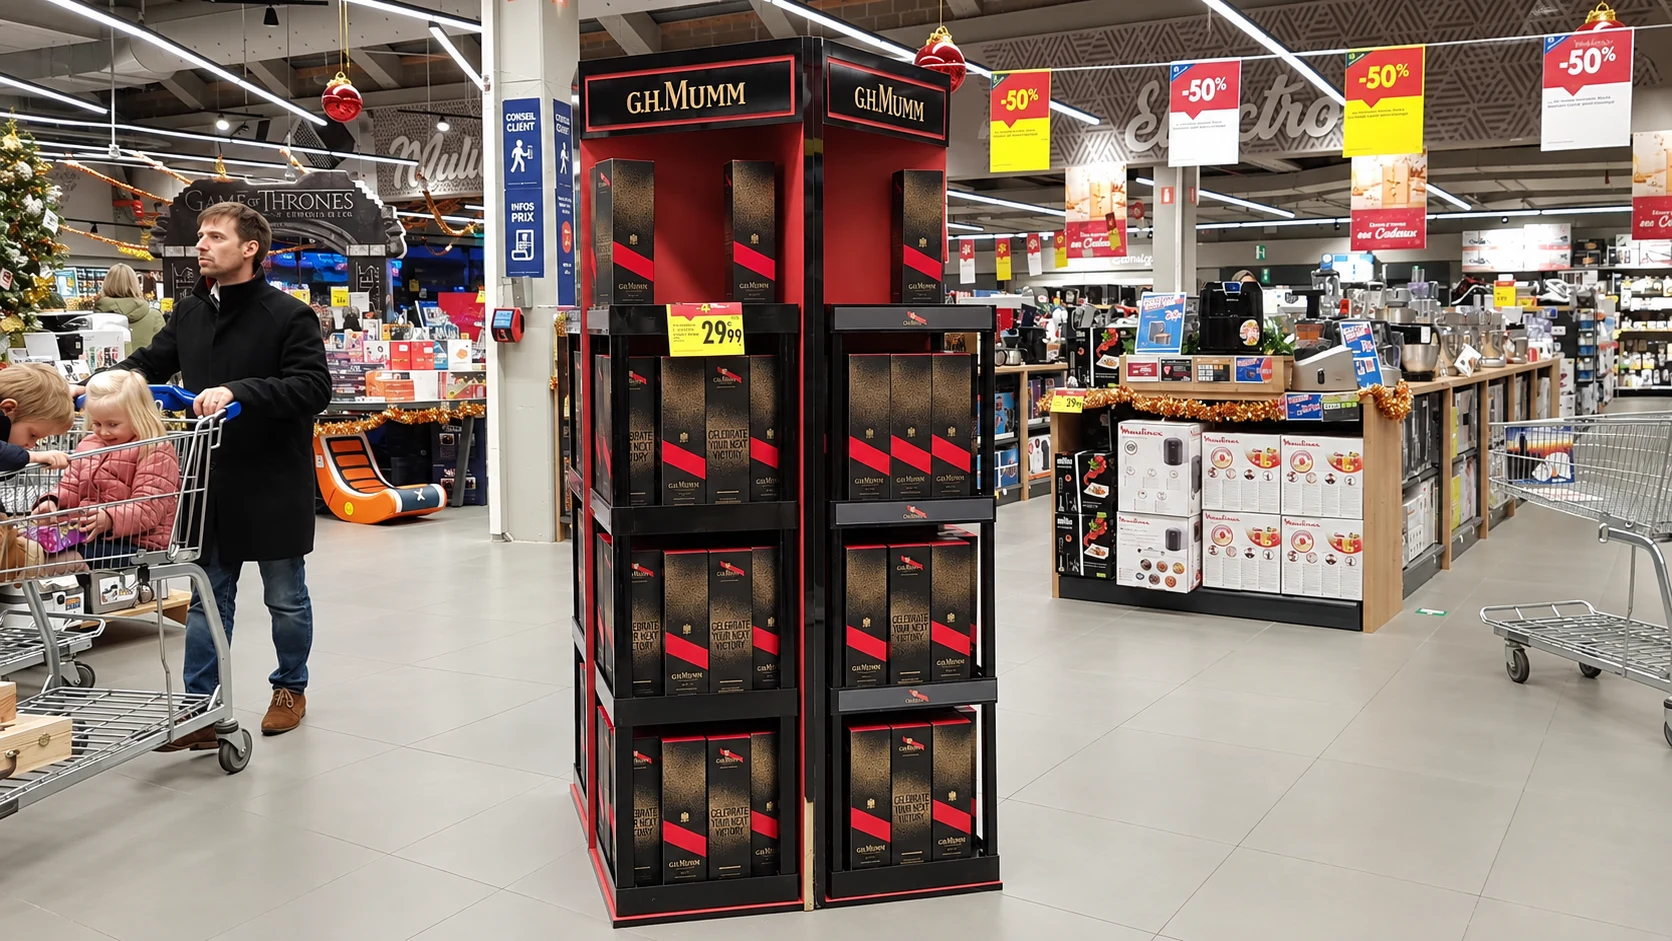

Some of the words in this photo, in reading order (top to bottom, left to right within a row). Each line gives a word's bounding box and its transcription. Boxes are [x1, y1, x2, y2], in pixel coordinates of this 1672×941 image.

[1558, 45, 1617, 76] -50%
[1358, 63, 1410, 90] -50%
[1000, 88, 1039, 111] -50%
[1181, 76, 1227, 102] -50%
[505, 112, 536, 122] CONSEIL
[1124, 74, 1345, 152] Ectro
[506, 122, 535, 132] CLIENT
[257, 189, 355, 212] THRONES
[511, 202, 535, 211] INFOS
[511, 212, 535, 222] PRIX
